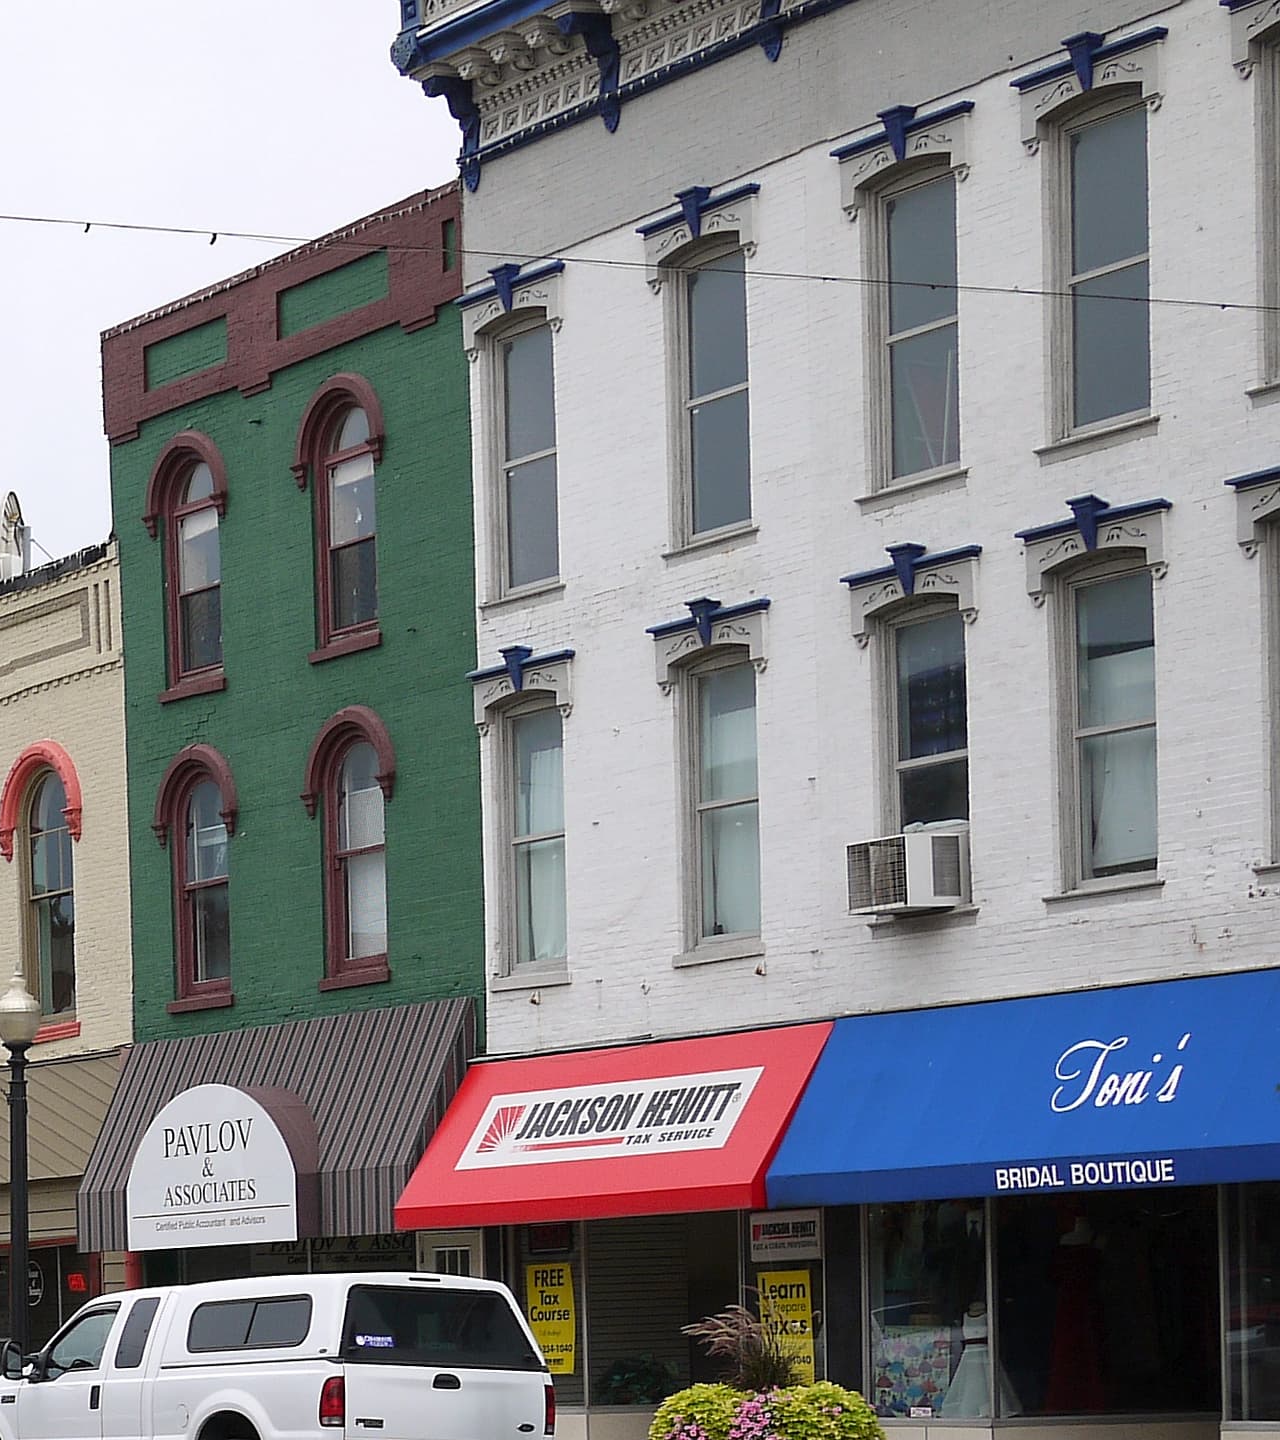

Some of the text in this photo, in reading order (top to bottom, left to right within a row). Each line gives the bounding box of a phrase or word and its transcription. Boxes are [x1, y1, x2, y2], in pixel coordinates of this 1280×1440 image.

[1050, 1032, 1191, 1113] Toni's
[514, 1082, 742, 1140] JACKSON HEWITT
[162, 1118, 253, 1158] PAVLOV
[625, 1127, 715, 1146] TAX SERVICE
[202, 1157, 214, 1178] &
[995, 1158, 1176, 1190] BRIDAL BOUTIQUE
[164, 1178, 257, 1208] ASSOCIATES
[533, 1268, 565, 1288] FREE
[761, 1278, 807, 1301] Learn
[538, 1290, 560, 1306] Tax
[530, 1305, 571, 1322] Course
